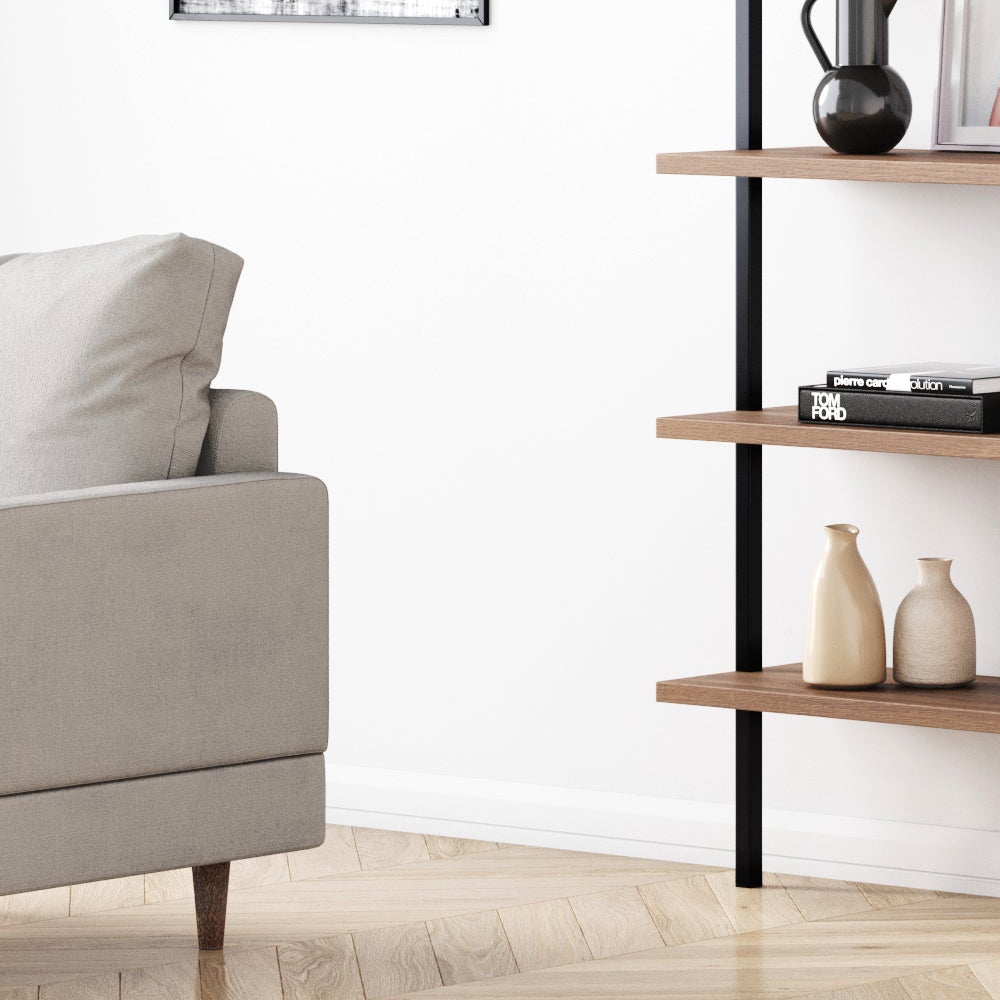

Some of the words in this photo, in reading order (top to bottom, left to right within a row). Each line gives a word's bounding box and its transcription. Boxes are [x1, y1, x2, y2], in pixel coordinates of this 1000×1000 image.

[833, 375, 864, 388] pierre
[910, 378, 943, 392] olution
[811, 393, 841, 408] TOM
[811, 406, 847, 421] FORD
